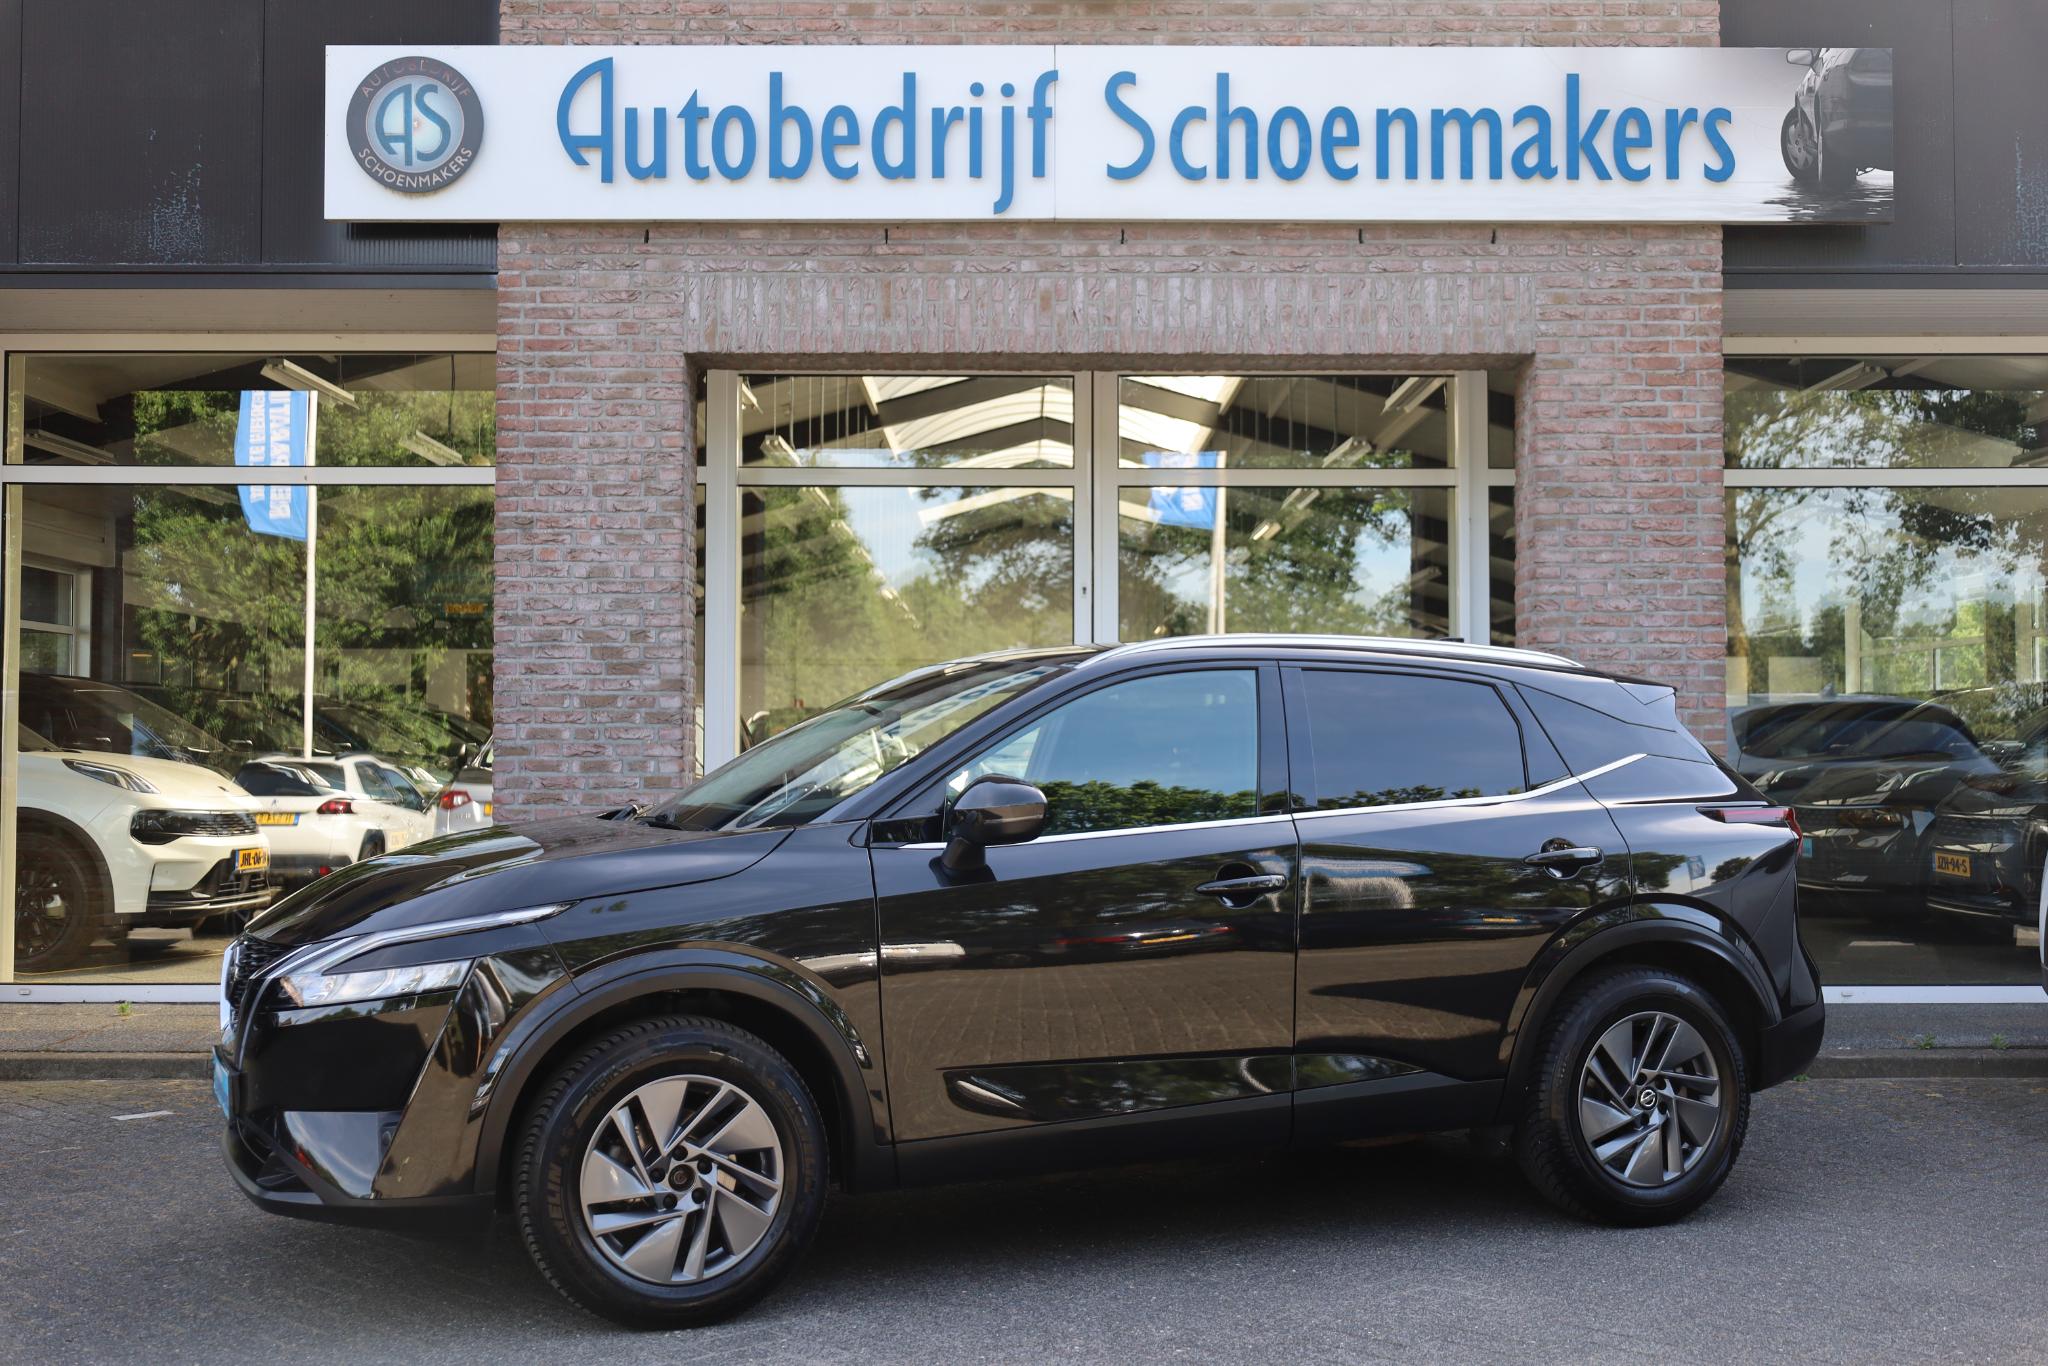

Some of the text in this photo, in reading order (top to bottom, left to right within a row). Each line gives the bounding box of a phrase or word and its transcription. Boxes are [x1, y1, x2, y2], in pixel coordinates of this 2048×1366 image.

[375, 83, 451, 167] AS
[556, 56, 1737, 214] Autobedrijf Schoenmakers
[358, 147, 473, 188] SCHOENMAKERS
